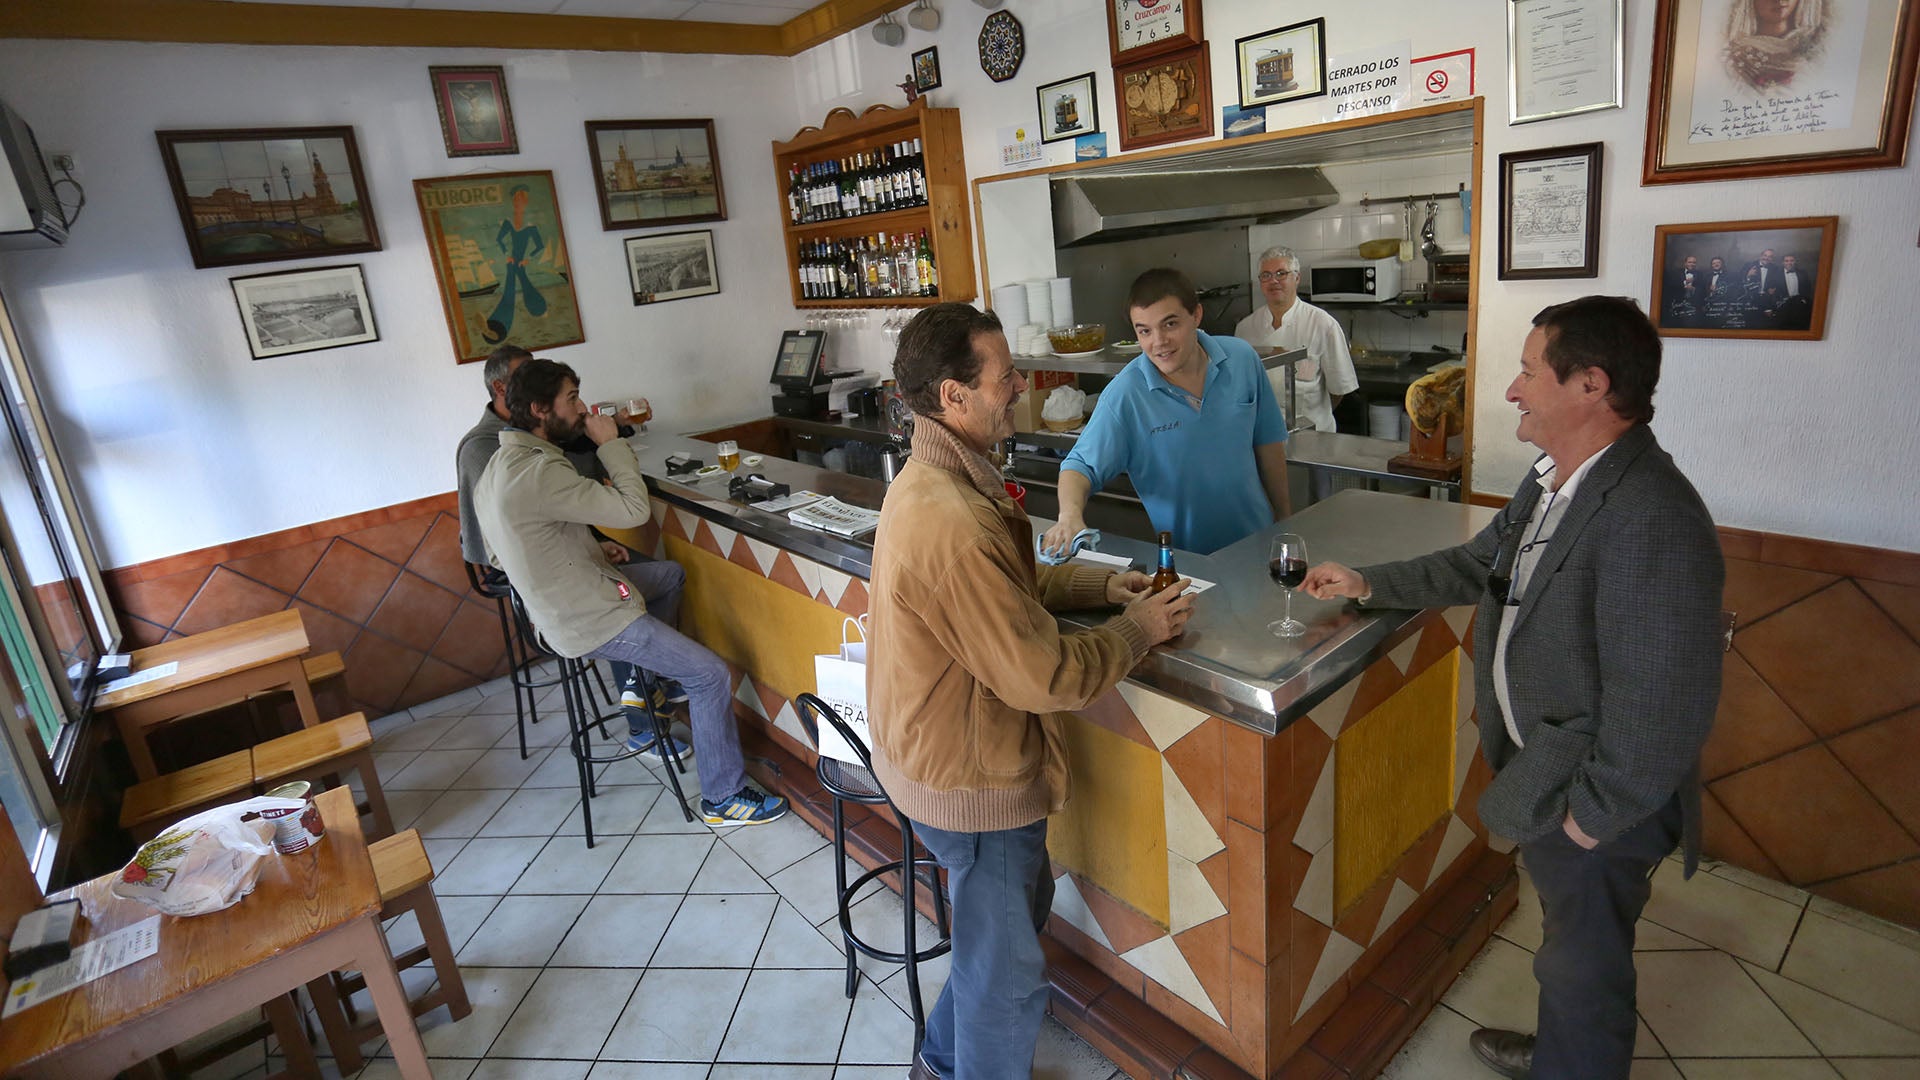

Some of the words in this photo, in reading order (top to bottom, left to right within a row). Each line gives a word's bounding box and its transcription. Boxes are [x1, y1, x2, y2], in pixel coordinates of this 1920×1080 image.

[1122, 0, 1129, 11] 9
[1174, 4, 1182, 14] 4
[1134, 3, 1171, 21] Cruzcampo
[1124, 20, 1131, 31] 8
[1164, 21, 1171, 32] 5
[1136, 30, 1142, 41] 7
[1149, 28, 1156, 39] 6
[1328, 62, 1377, 81] CERRADO
[1379, 56, 1399, 71] LOS
[1330, 80, 1372, 98] MARTES
[1374, 75, 1397, 90] POR
[1336, 95, 1392, 114] DESCANSO
